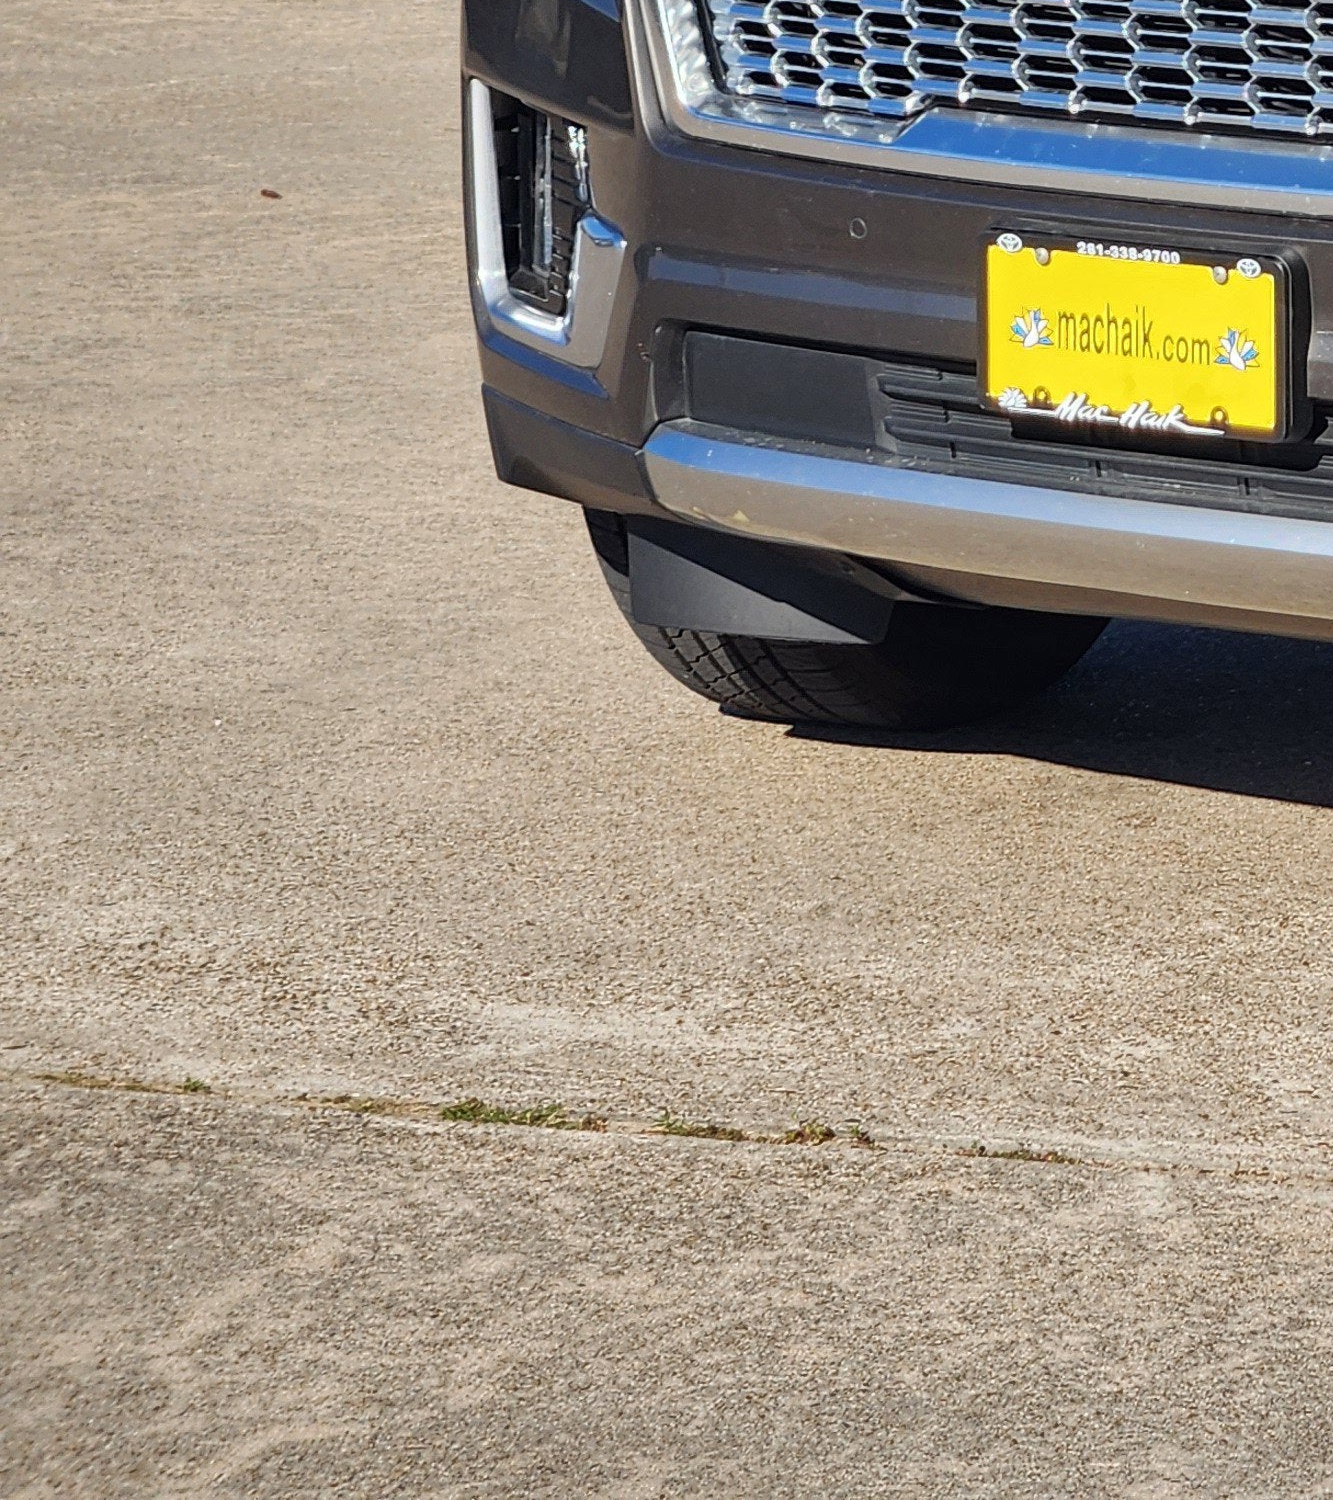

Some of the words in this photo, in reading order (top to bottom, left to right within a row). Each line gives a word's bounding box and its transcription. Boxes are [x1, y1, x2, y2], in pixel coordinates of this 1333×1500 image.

[1056, 303, 1210, 366] machaik.com
[1052, 391, 1116, 423] Mac
[1117, 399, 1200, 434] Haik
